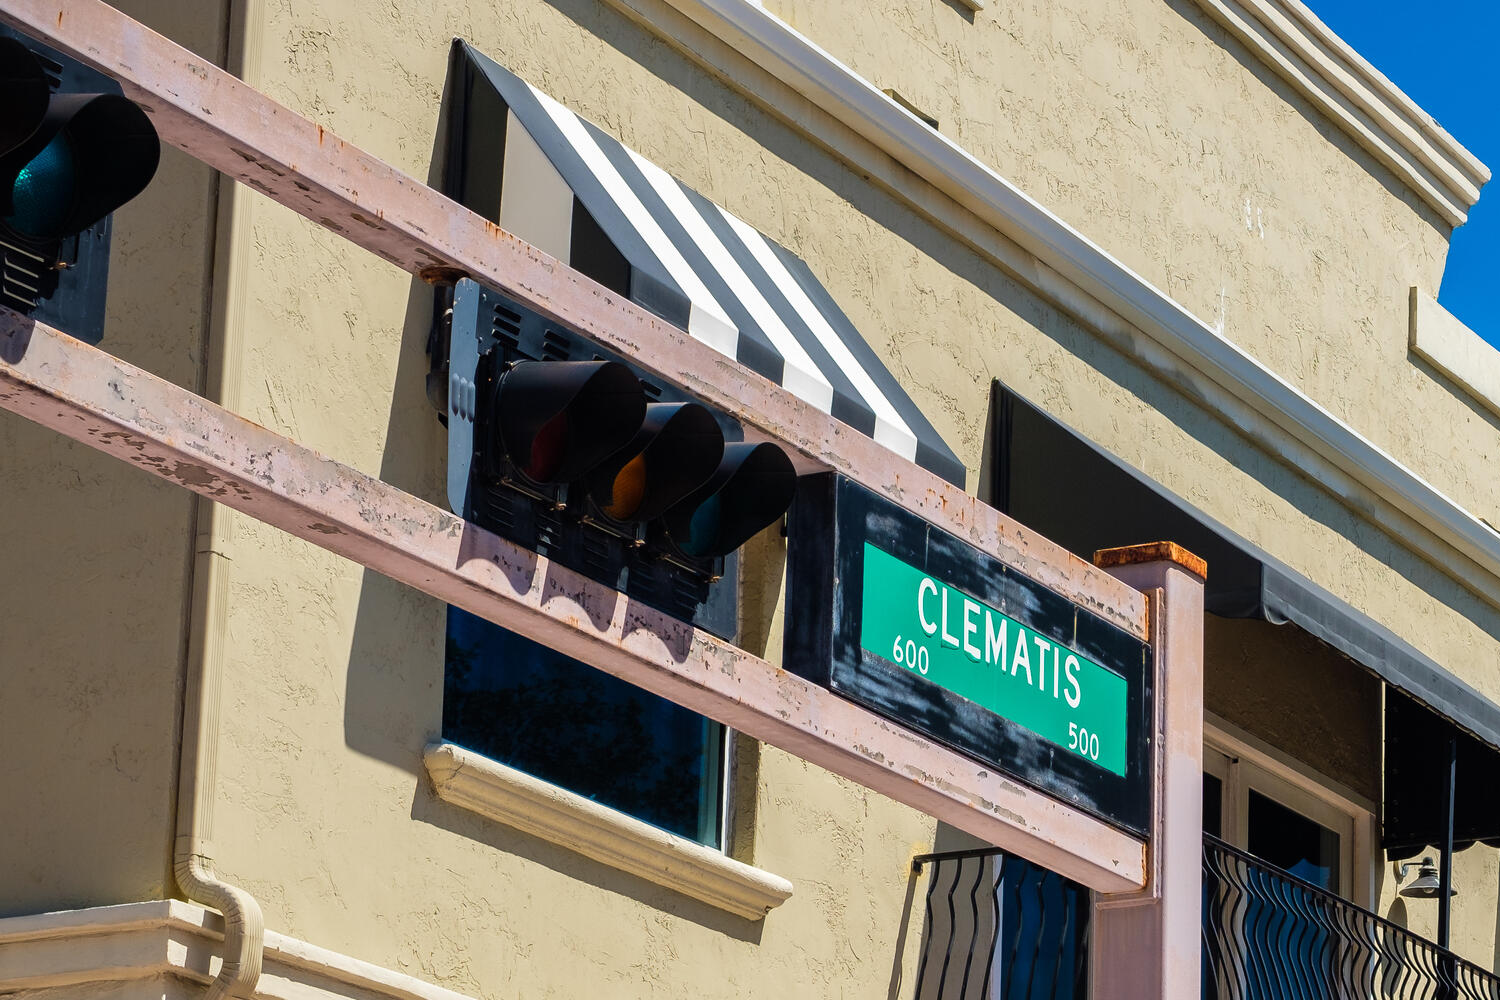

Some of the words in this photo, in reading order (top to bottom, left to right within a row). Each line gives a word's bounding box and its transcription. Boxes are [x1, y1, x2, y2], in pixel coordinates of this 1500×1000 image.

[892, 634, 930, 675] 600
[917, 577, 1081, 709] CLEMATIS
[1068, 721, 1100, 761] 500
